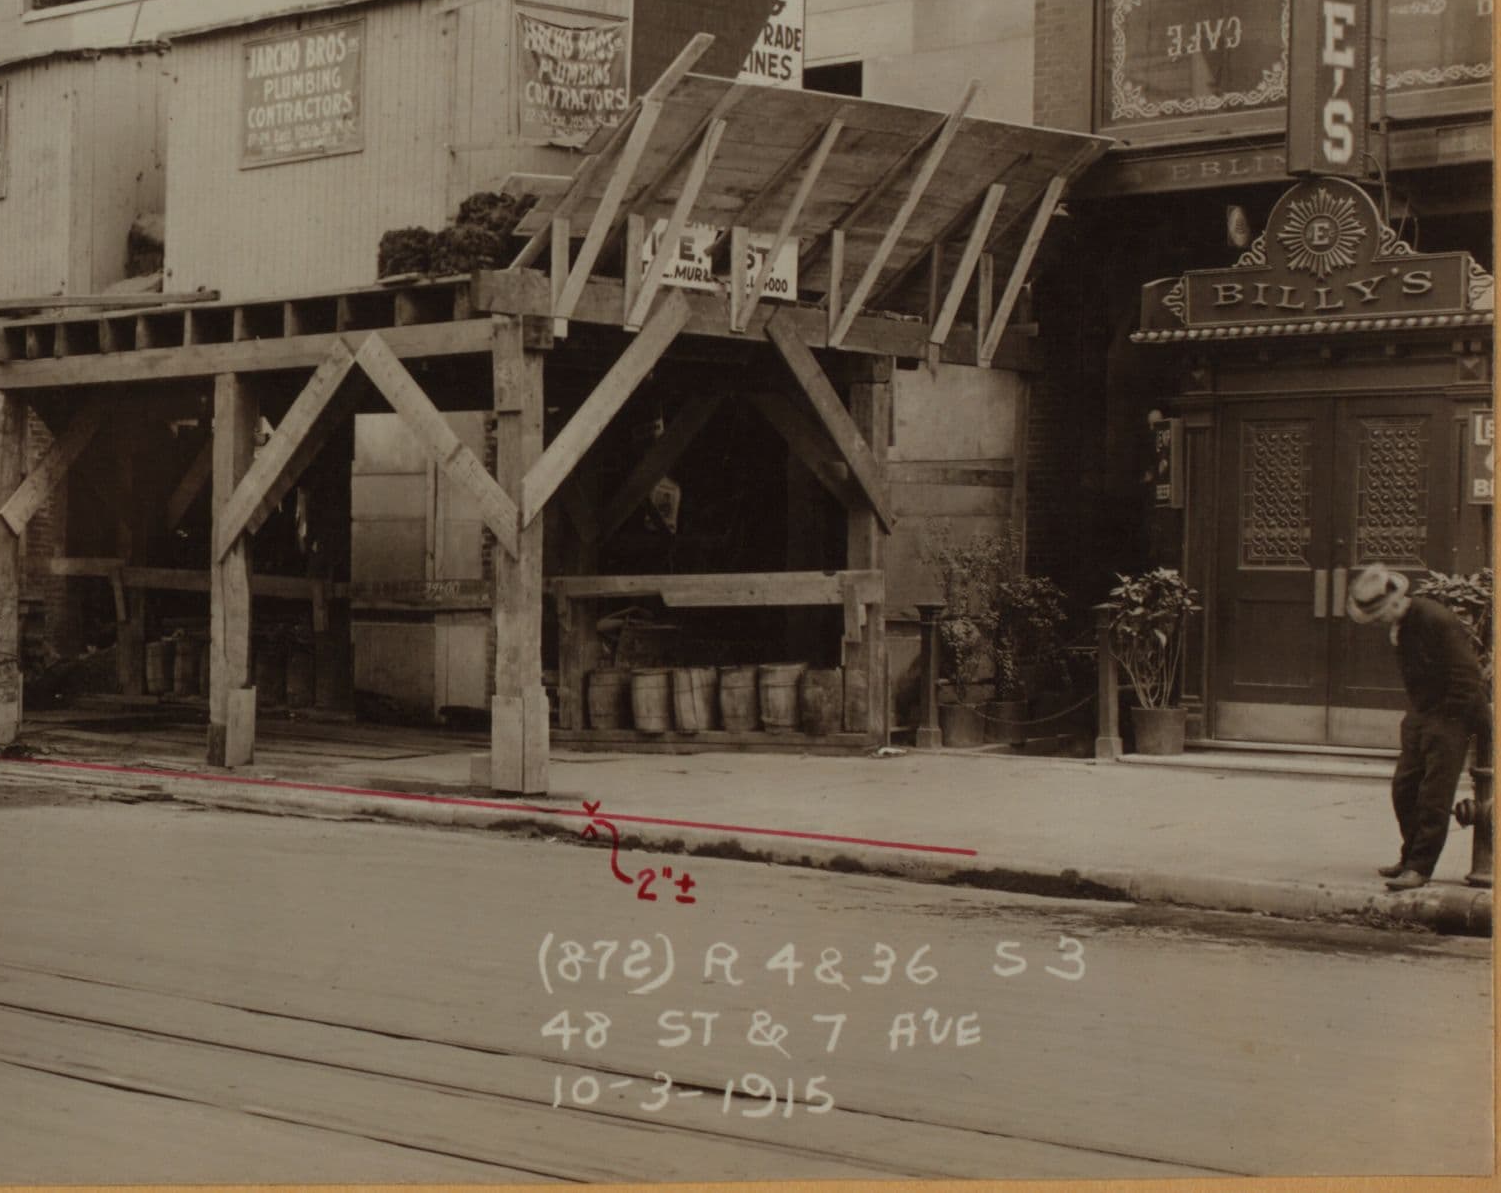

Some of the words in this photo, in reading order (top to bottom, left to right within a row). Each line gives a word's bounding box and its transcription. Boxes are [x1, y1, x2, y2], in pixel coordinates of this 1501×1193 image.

[763, 22, 802, 52] RADE
[263, 66, 342, 103] PLUMBING
[247, 89, 354, 129] CONTRACTORS
[1211, 268, 1434, 311] BILLY'S
